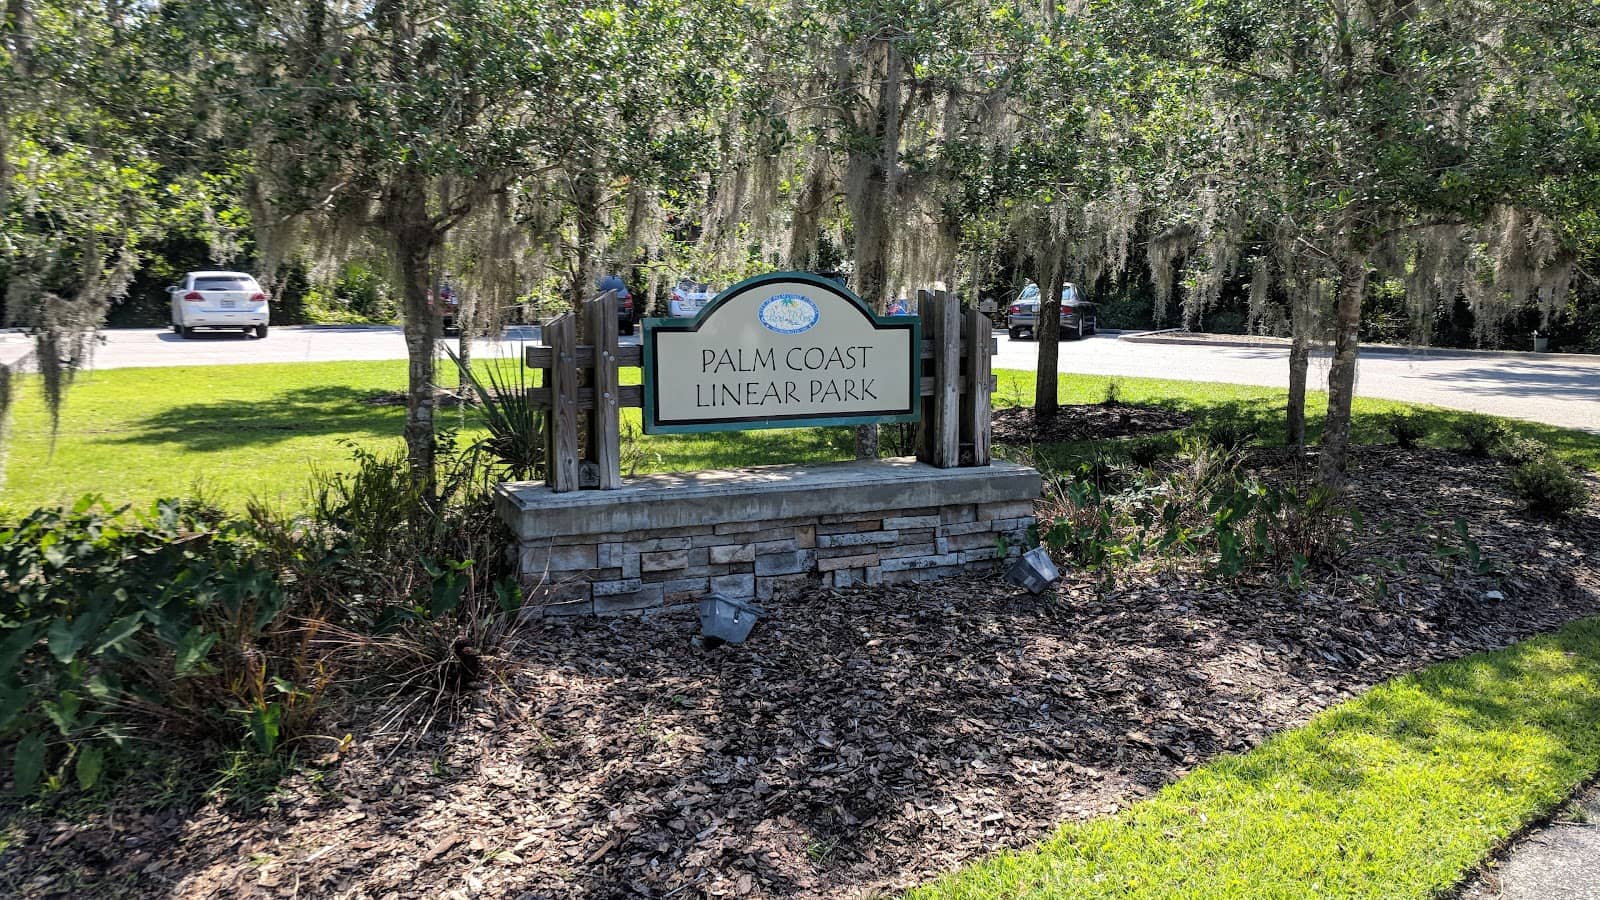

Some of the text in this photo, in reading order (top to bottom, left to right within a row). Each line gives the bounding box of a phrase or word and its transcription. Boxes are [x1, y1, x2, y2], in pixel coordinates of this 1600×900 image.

[702, 346, 873, 373] PALM COAST
[696, 379, 878, 407] LINEAR PARK
